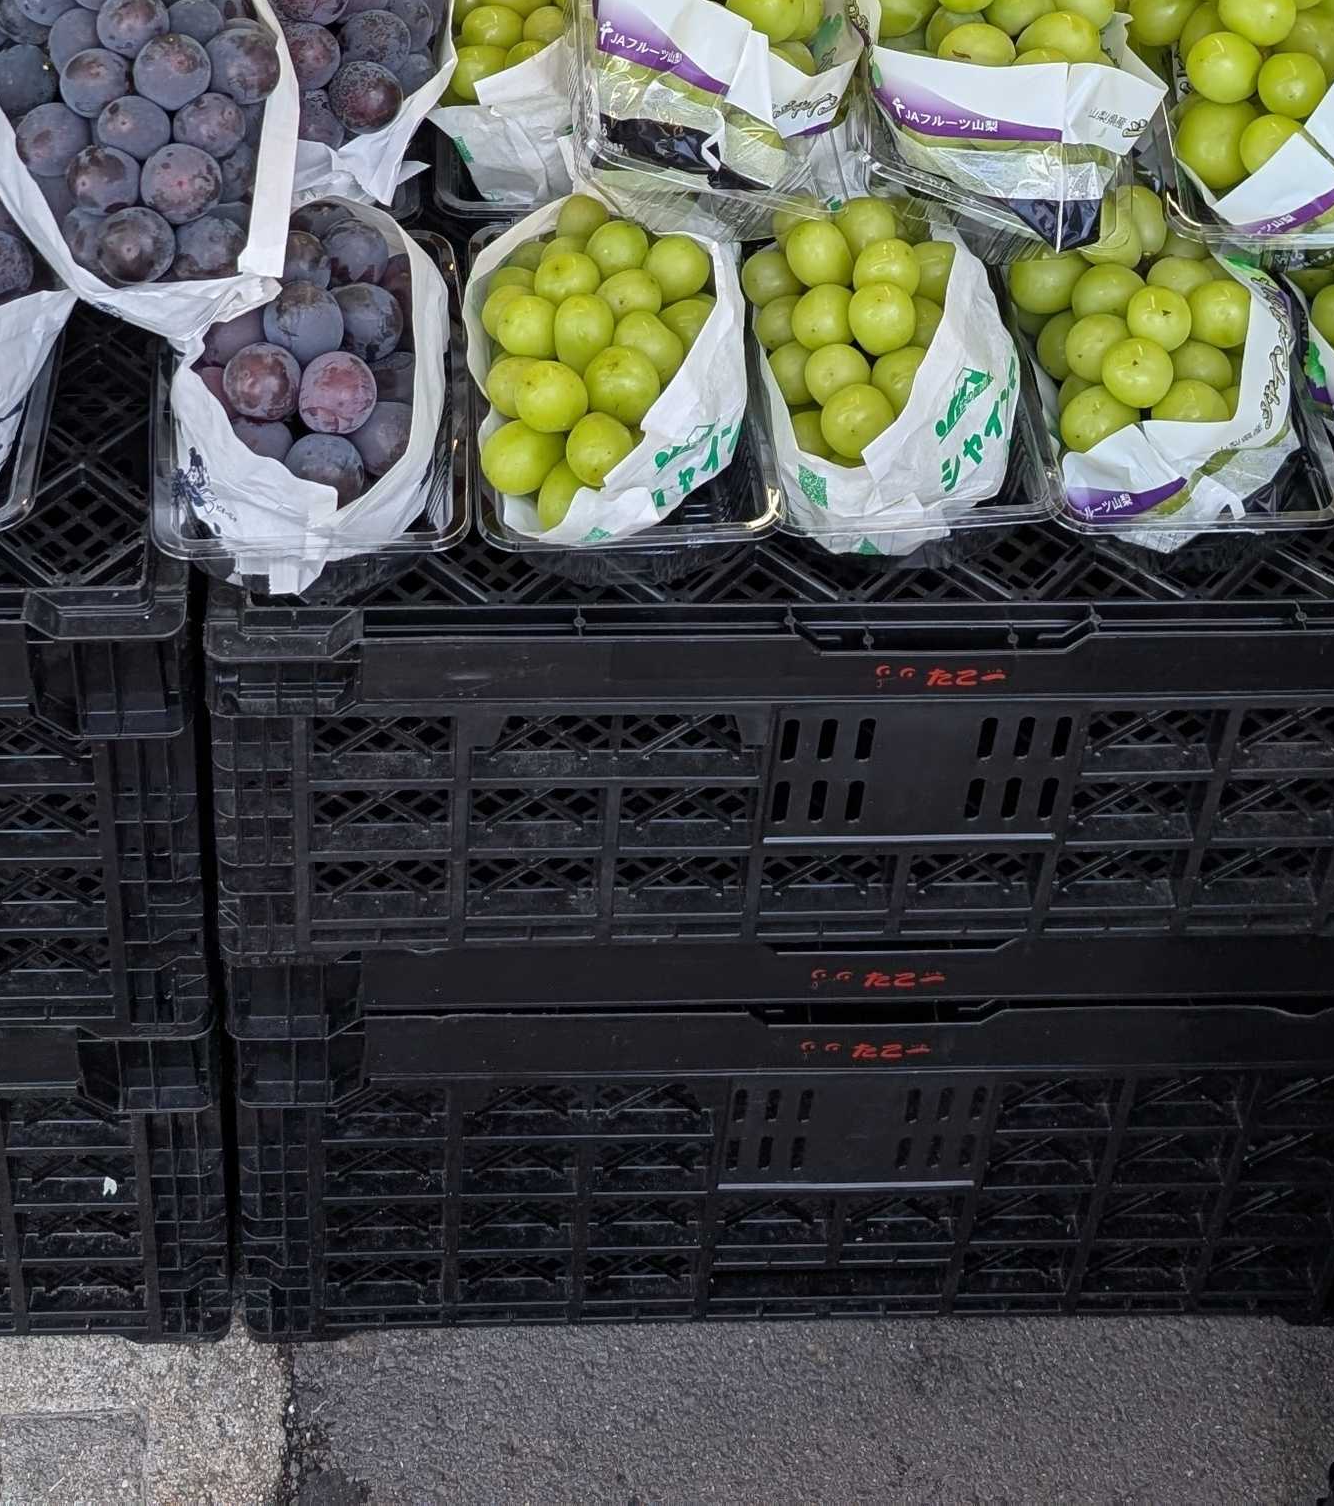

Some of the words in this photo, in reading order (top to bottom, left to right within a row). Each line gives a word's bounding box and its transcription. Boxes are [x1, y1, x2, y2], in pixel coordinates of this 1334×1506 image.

[611, 33, 683, 65] JAフルーツ山梨
[905, 112, 999, 132] JAフルーツ山梨
